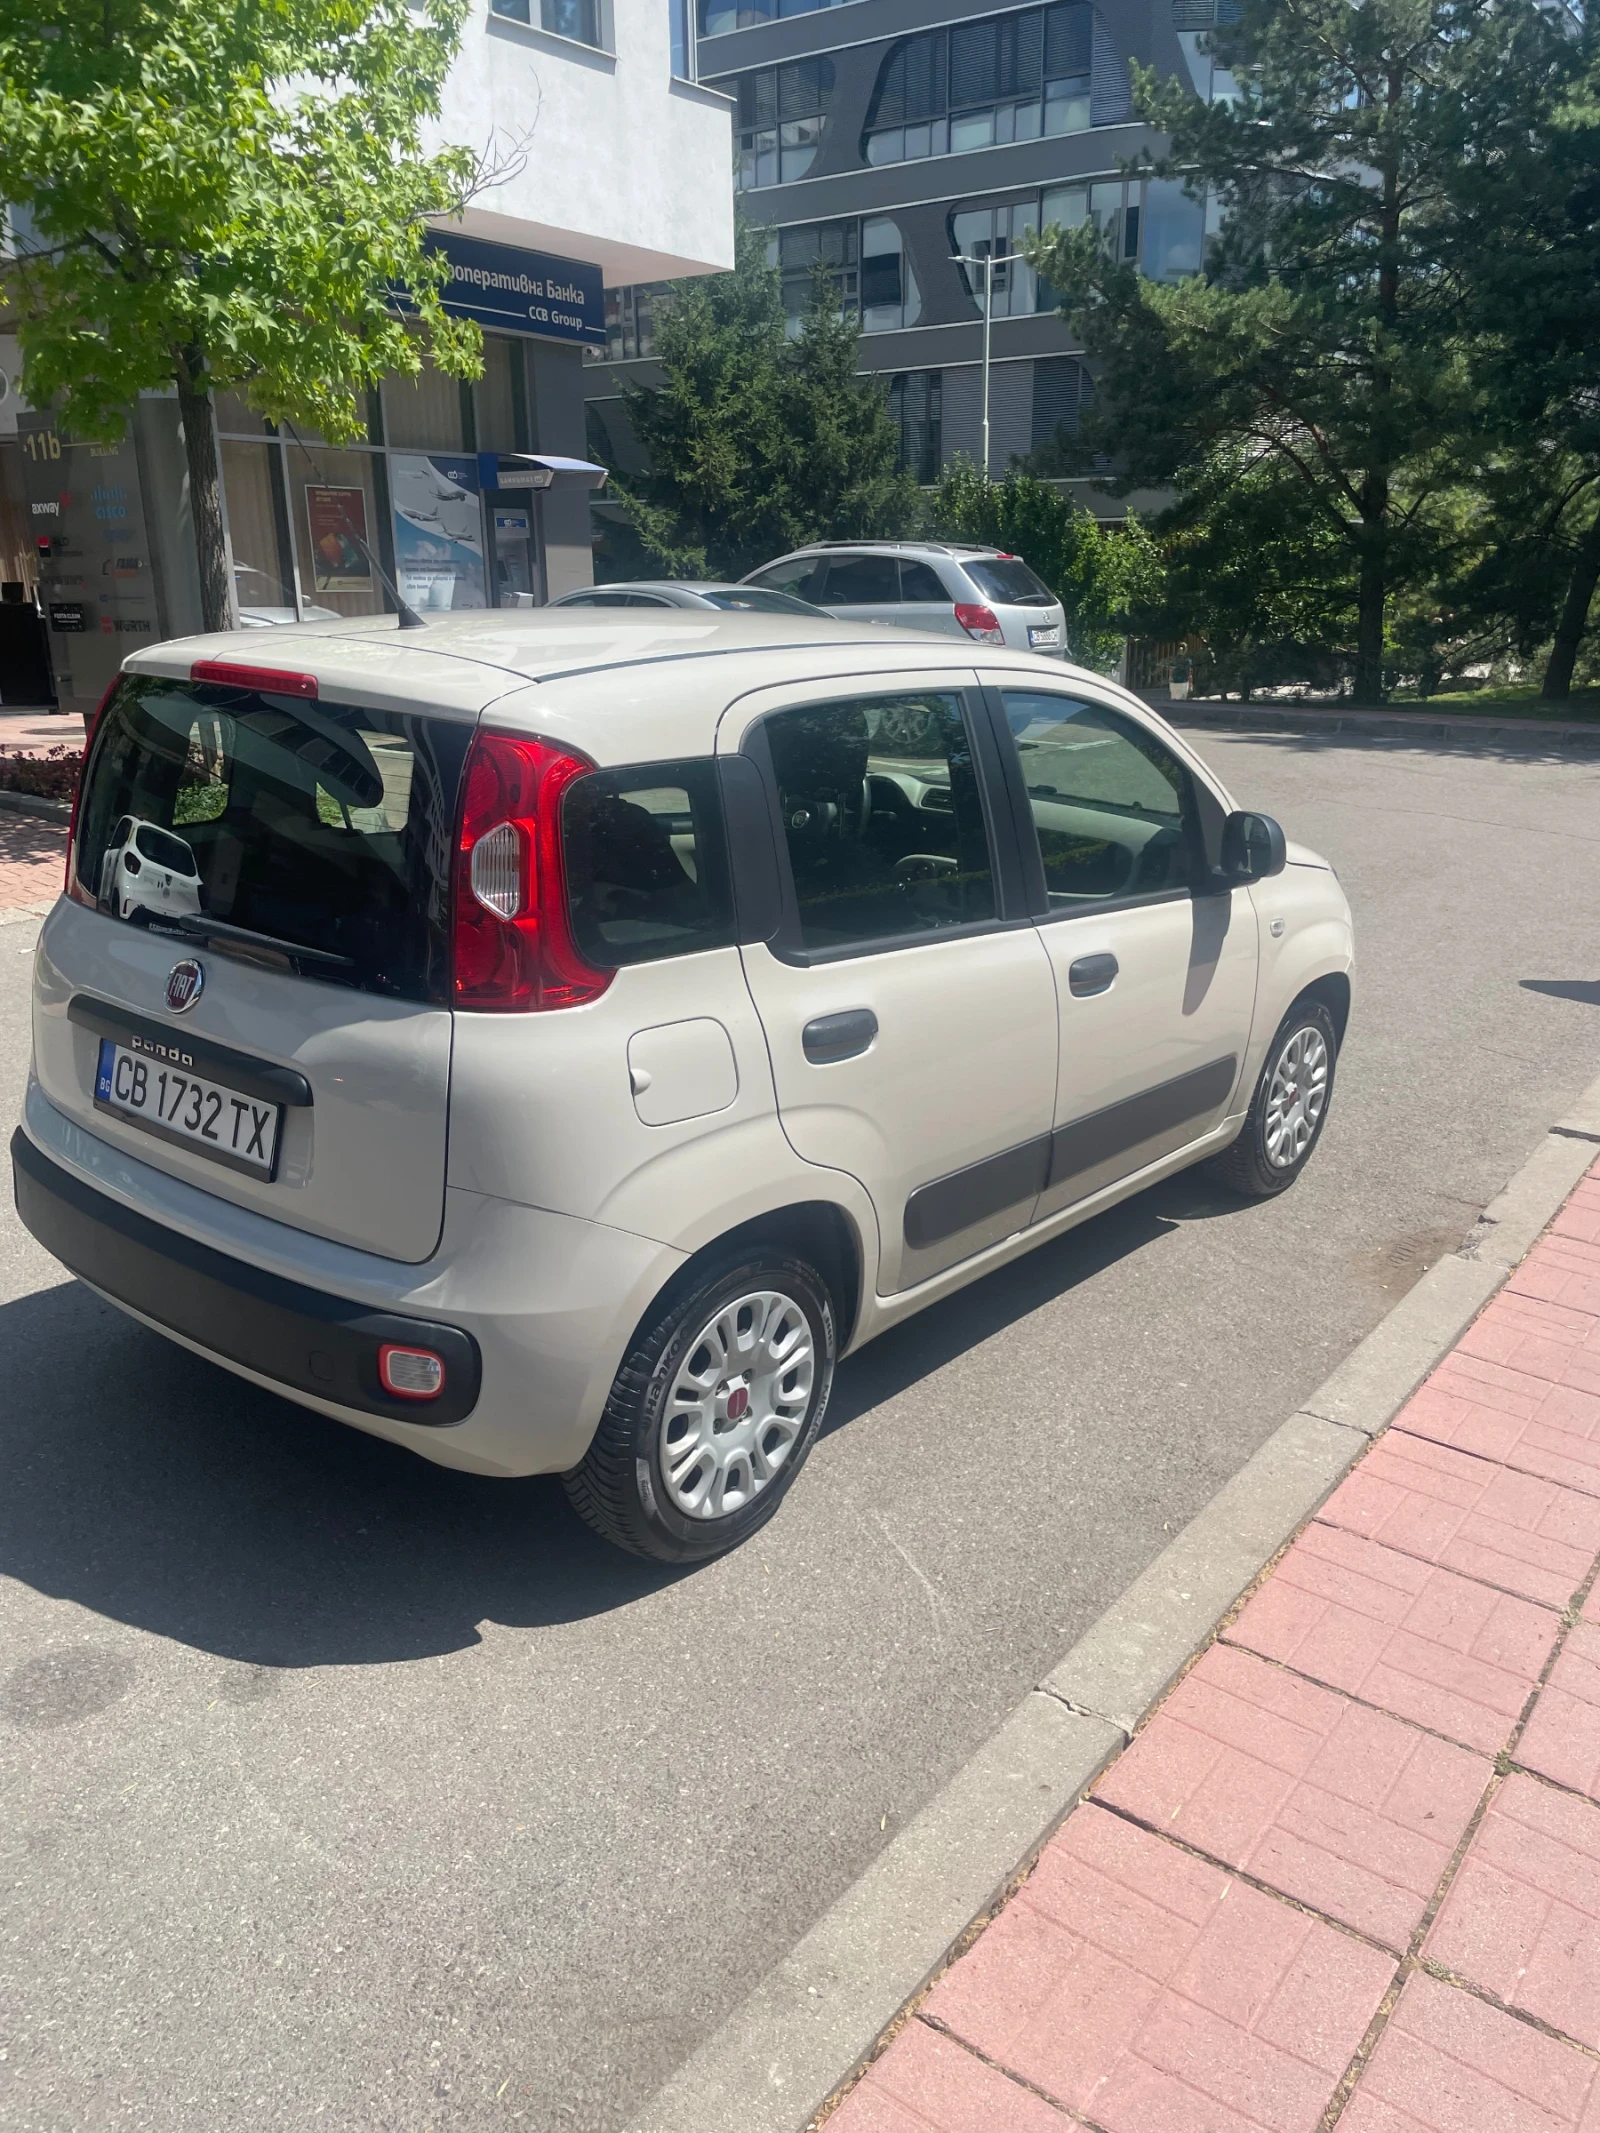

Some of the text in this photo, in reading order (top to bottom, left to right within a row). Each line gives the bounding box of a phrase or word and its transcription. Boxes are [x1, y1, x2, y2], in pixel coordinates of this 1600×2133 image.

[445, 263, 585, 305] ооперативна Банка
[529, 305, 583, 332] CCB Group
[27, 431, 61, 461] 11b
[32, 502, 60, 517] axway
[169, 973, 196, 1000] FIAT
[132, 1035, 193, 1067] panda
[100, 1077, 110, 1092] BG
[115, 1055, 271, 1160] CB 1732 TX
